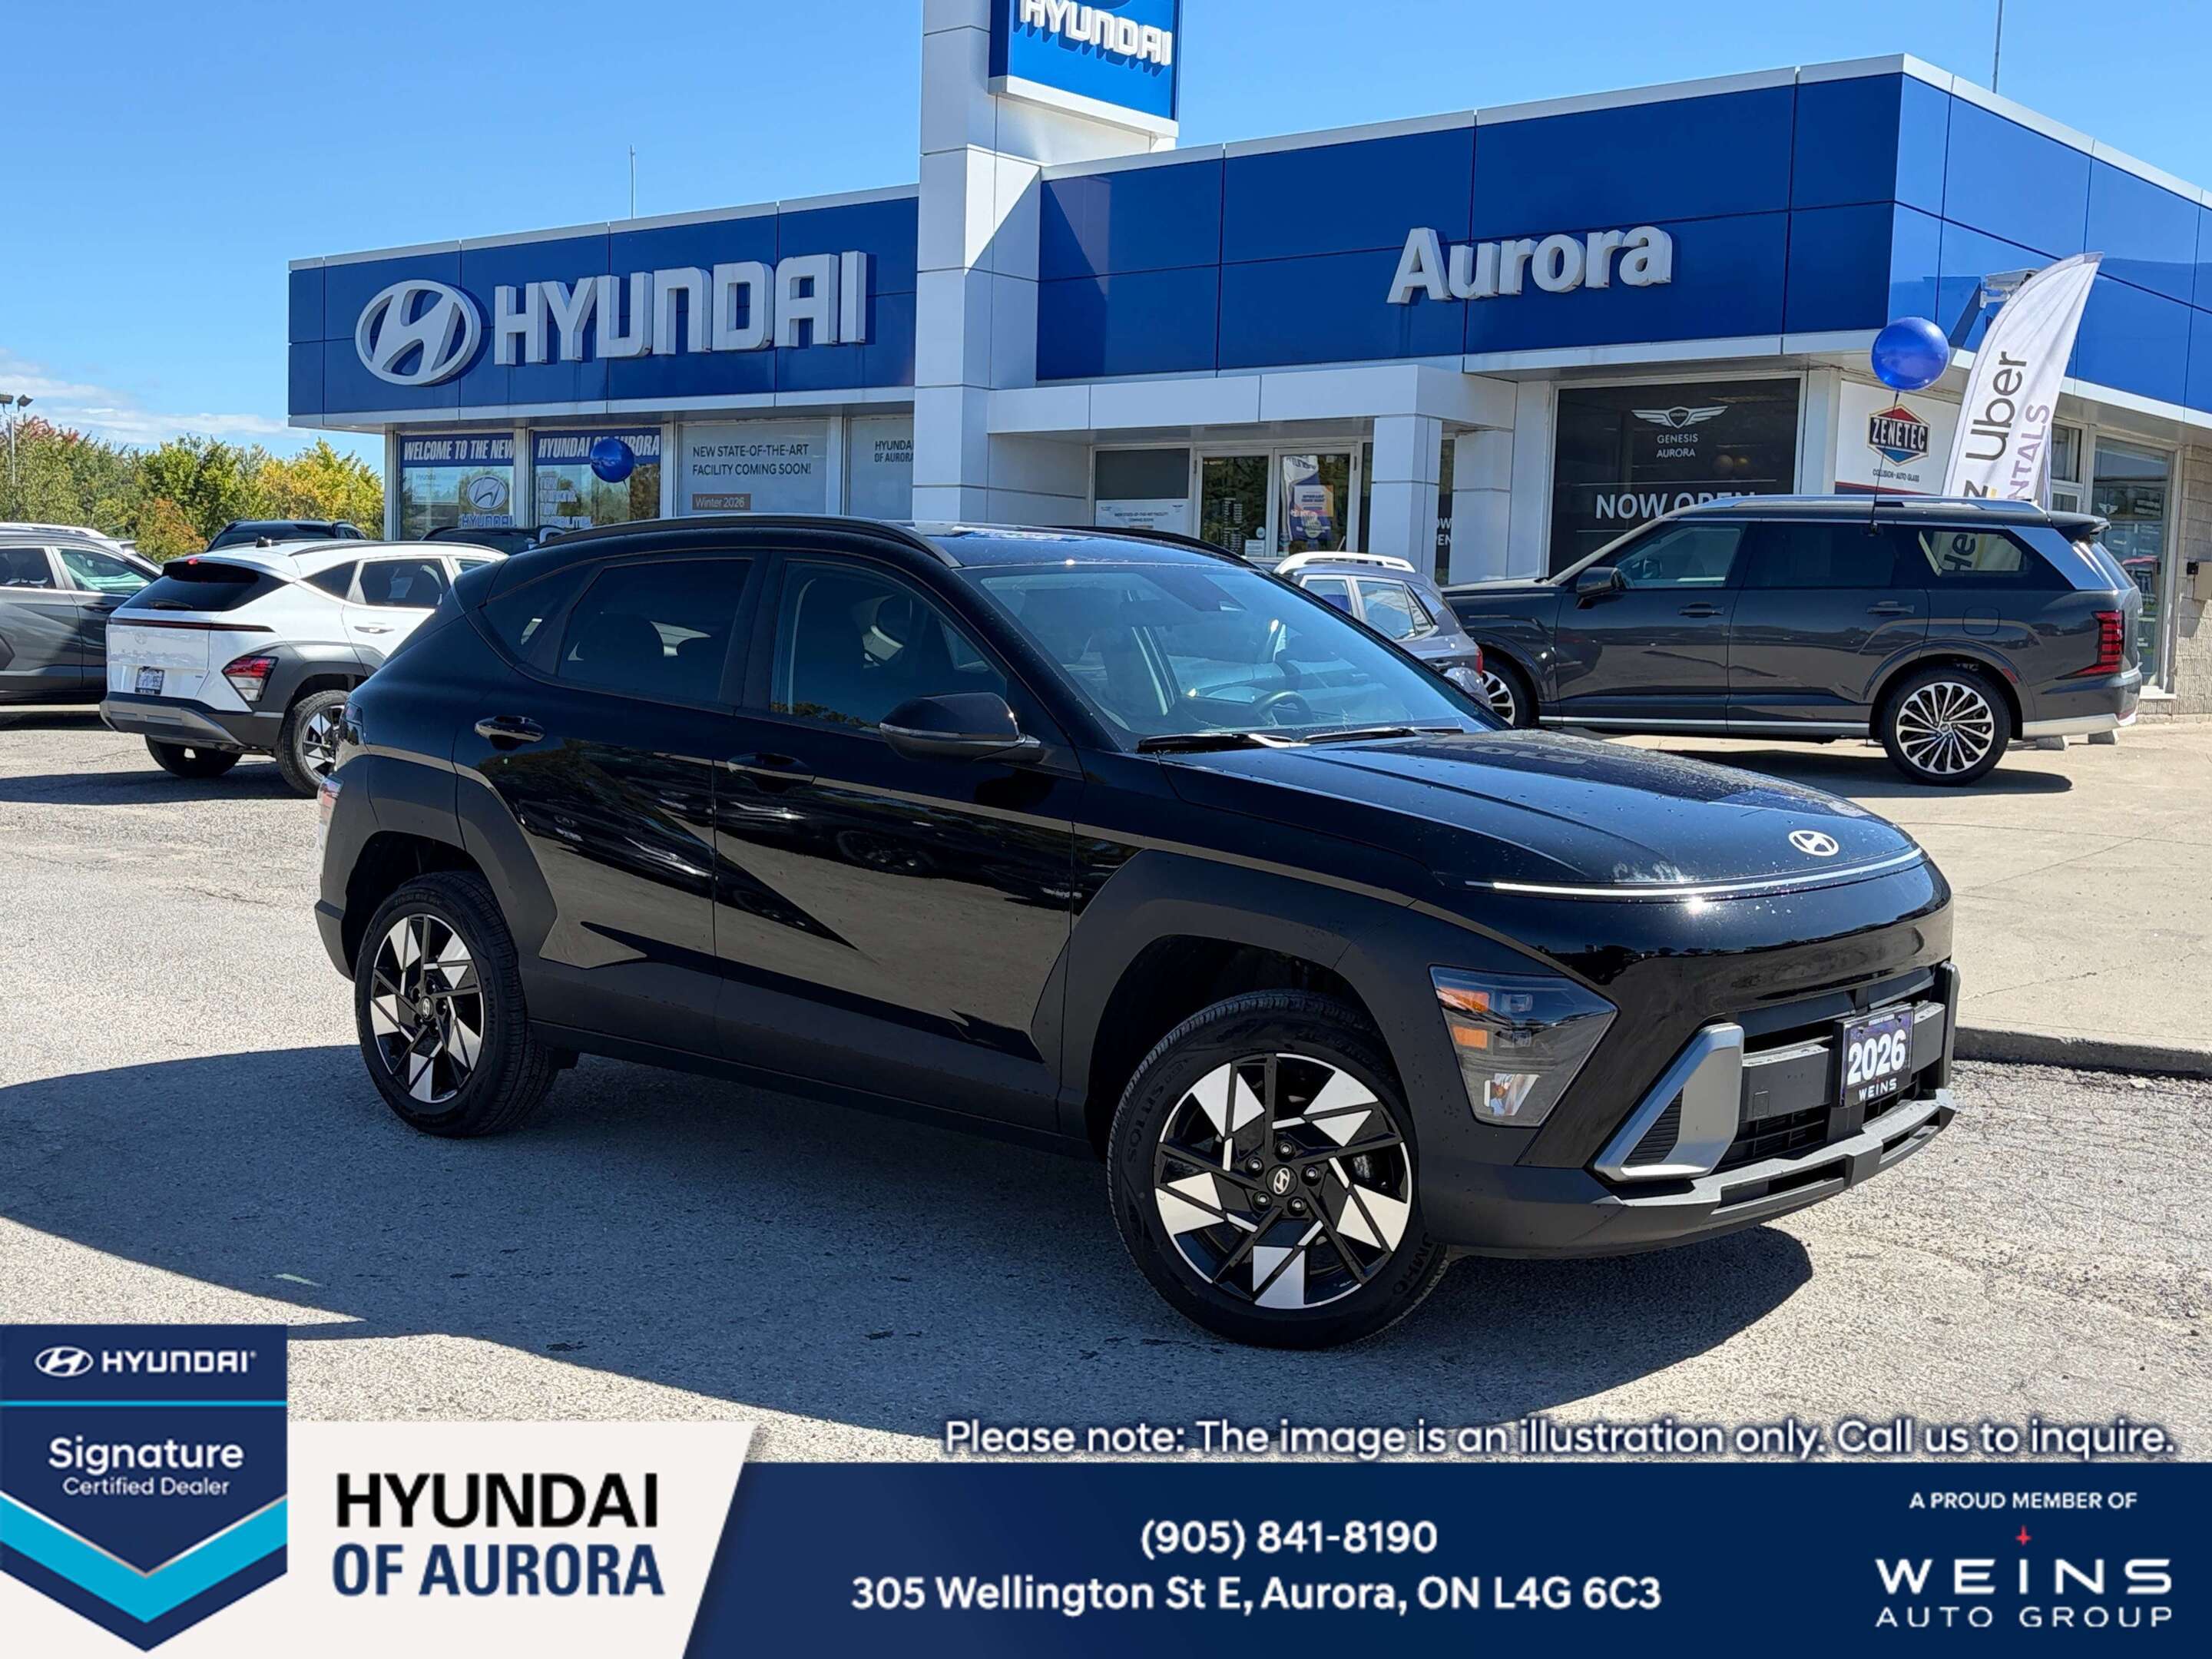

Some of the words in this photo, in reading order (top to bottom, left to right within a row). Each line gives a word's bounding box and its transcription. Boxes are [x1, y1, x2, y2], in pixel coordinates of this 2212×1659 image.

[1020, 0, 1173, 66] HYUNDAI
[1386, 226, 1673, 304] Aurora
[494, 251, 867, 365] HYUNDAI
[1965, 351, 2028, 461] Uber
[875, 440, 913, 451] HYUNDA
[1657, 433, 1698, 445] GENESIS
[1872, 419, 1926, 450] ZENETEC
[404, 440, 452, 461] WELCOME
[455, 440, 468, 459] TO
[470, 439, 489, 459] THE
[490, 439, 515, 459] NEW
[538, 436, 591, 459] HYUNDAI
[615, 435, 660, 456] RORA
[692, 445, 715, 458] NEW
[717, 444, 810, 457] STATE-OF-THE-ART
[874, 453, 883, 462] OF
[1656, 448, 1696, 459] AURORA
[2007, 404, 2051, 499] NTALS
[693, 463, 732, 475] FACILITY
[735, 463, 777, 475] COMING
[779, 462, 811, 475] SOON!
[695, 496, 723, 508] Winter
[724, 496, 745, 508] 2026
[1594, 492, 1668, 519] NOW
[1846, 1029, 1906, 1086] 2026
[1859, 1078, 1897, 1101] WEINS
